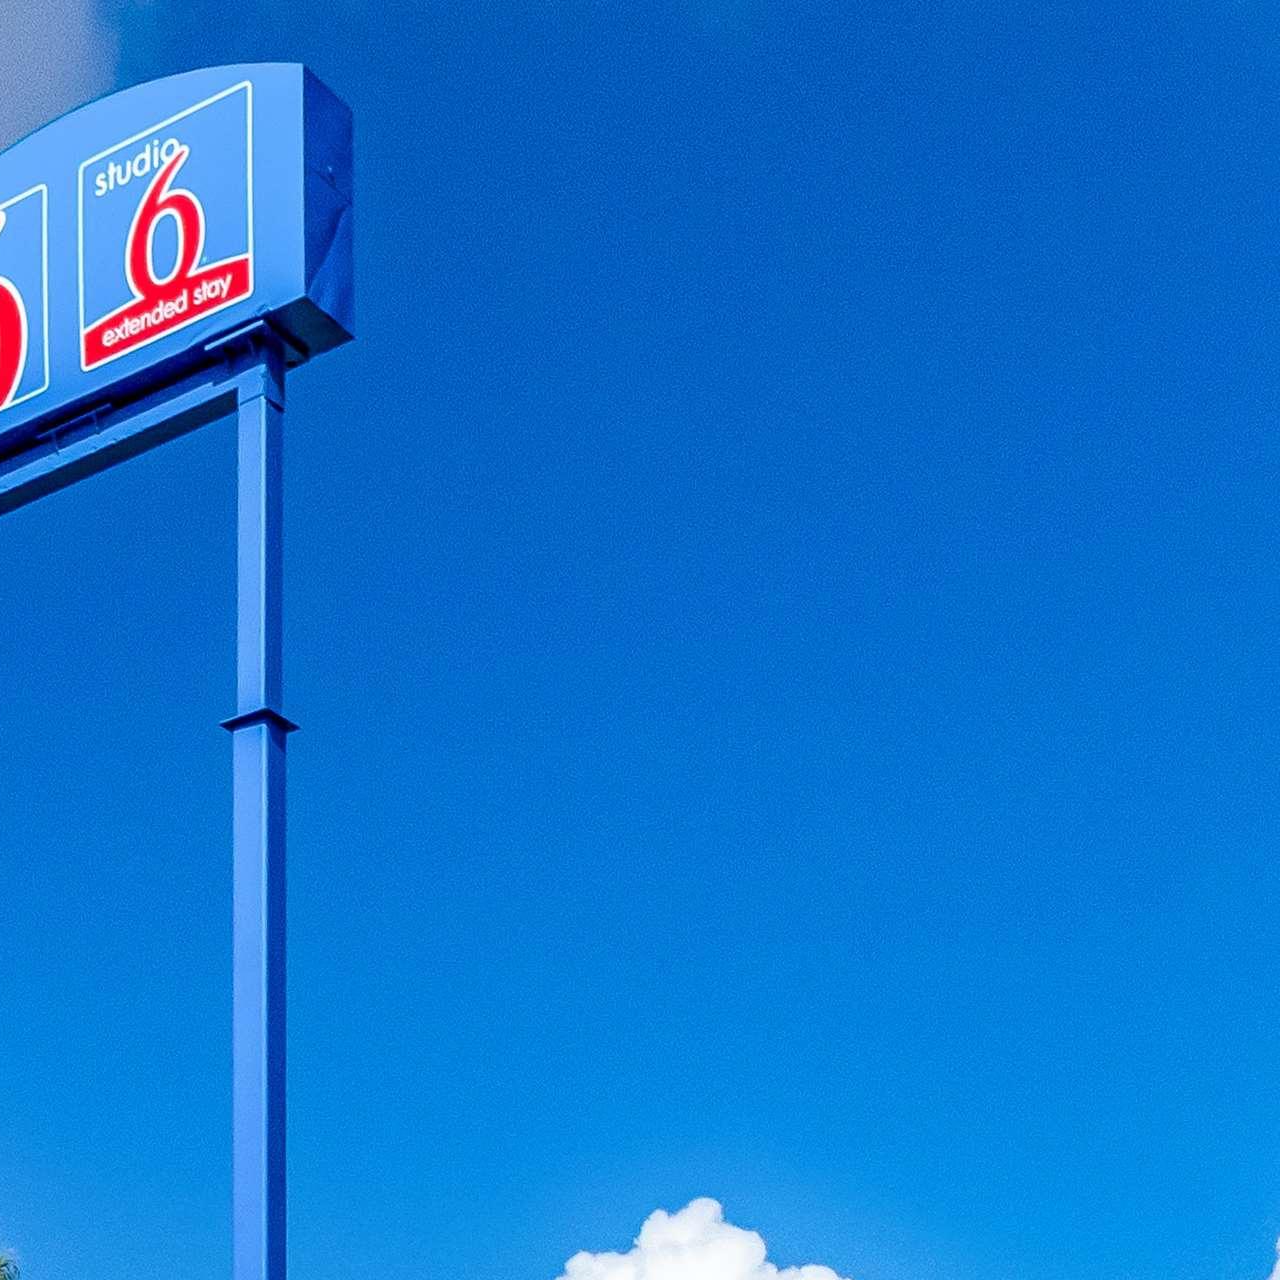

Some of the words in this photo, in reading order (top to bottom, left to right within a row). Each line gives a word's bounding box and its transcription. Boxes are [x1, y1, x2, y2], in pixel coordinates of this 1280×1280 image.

[95, 138, 180, 196] studio
[125, 145, 206, 300] 6
[101, 289, 189, 346] extended
[193, 274, 233, 305] stay
